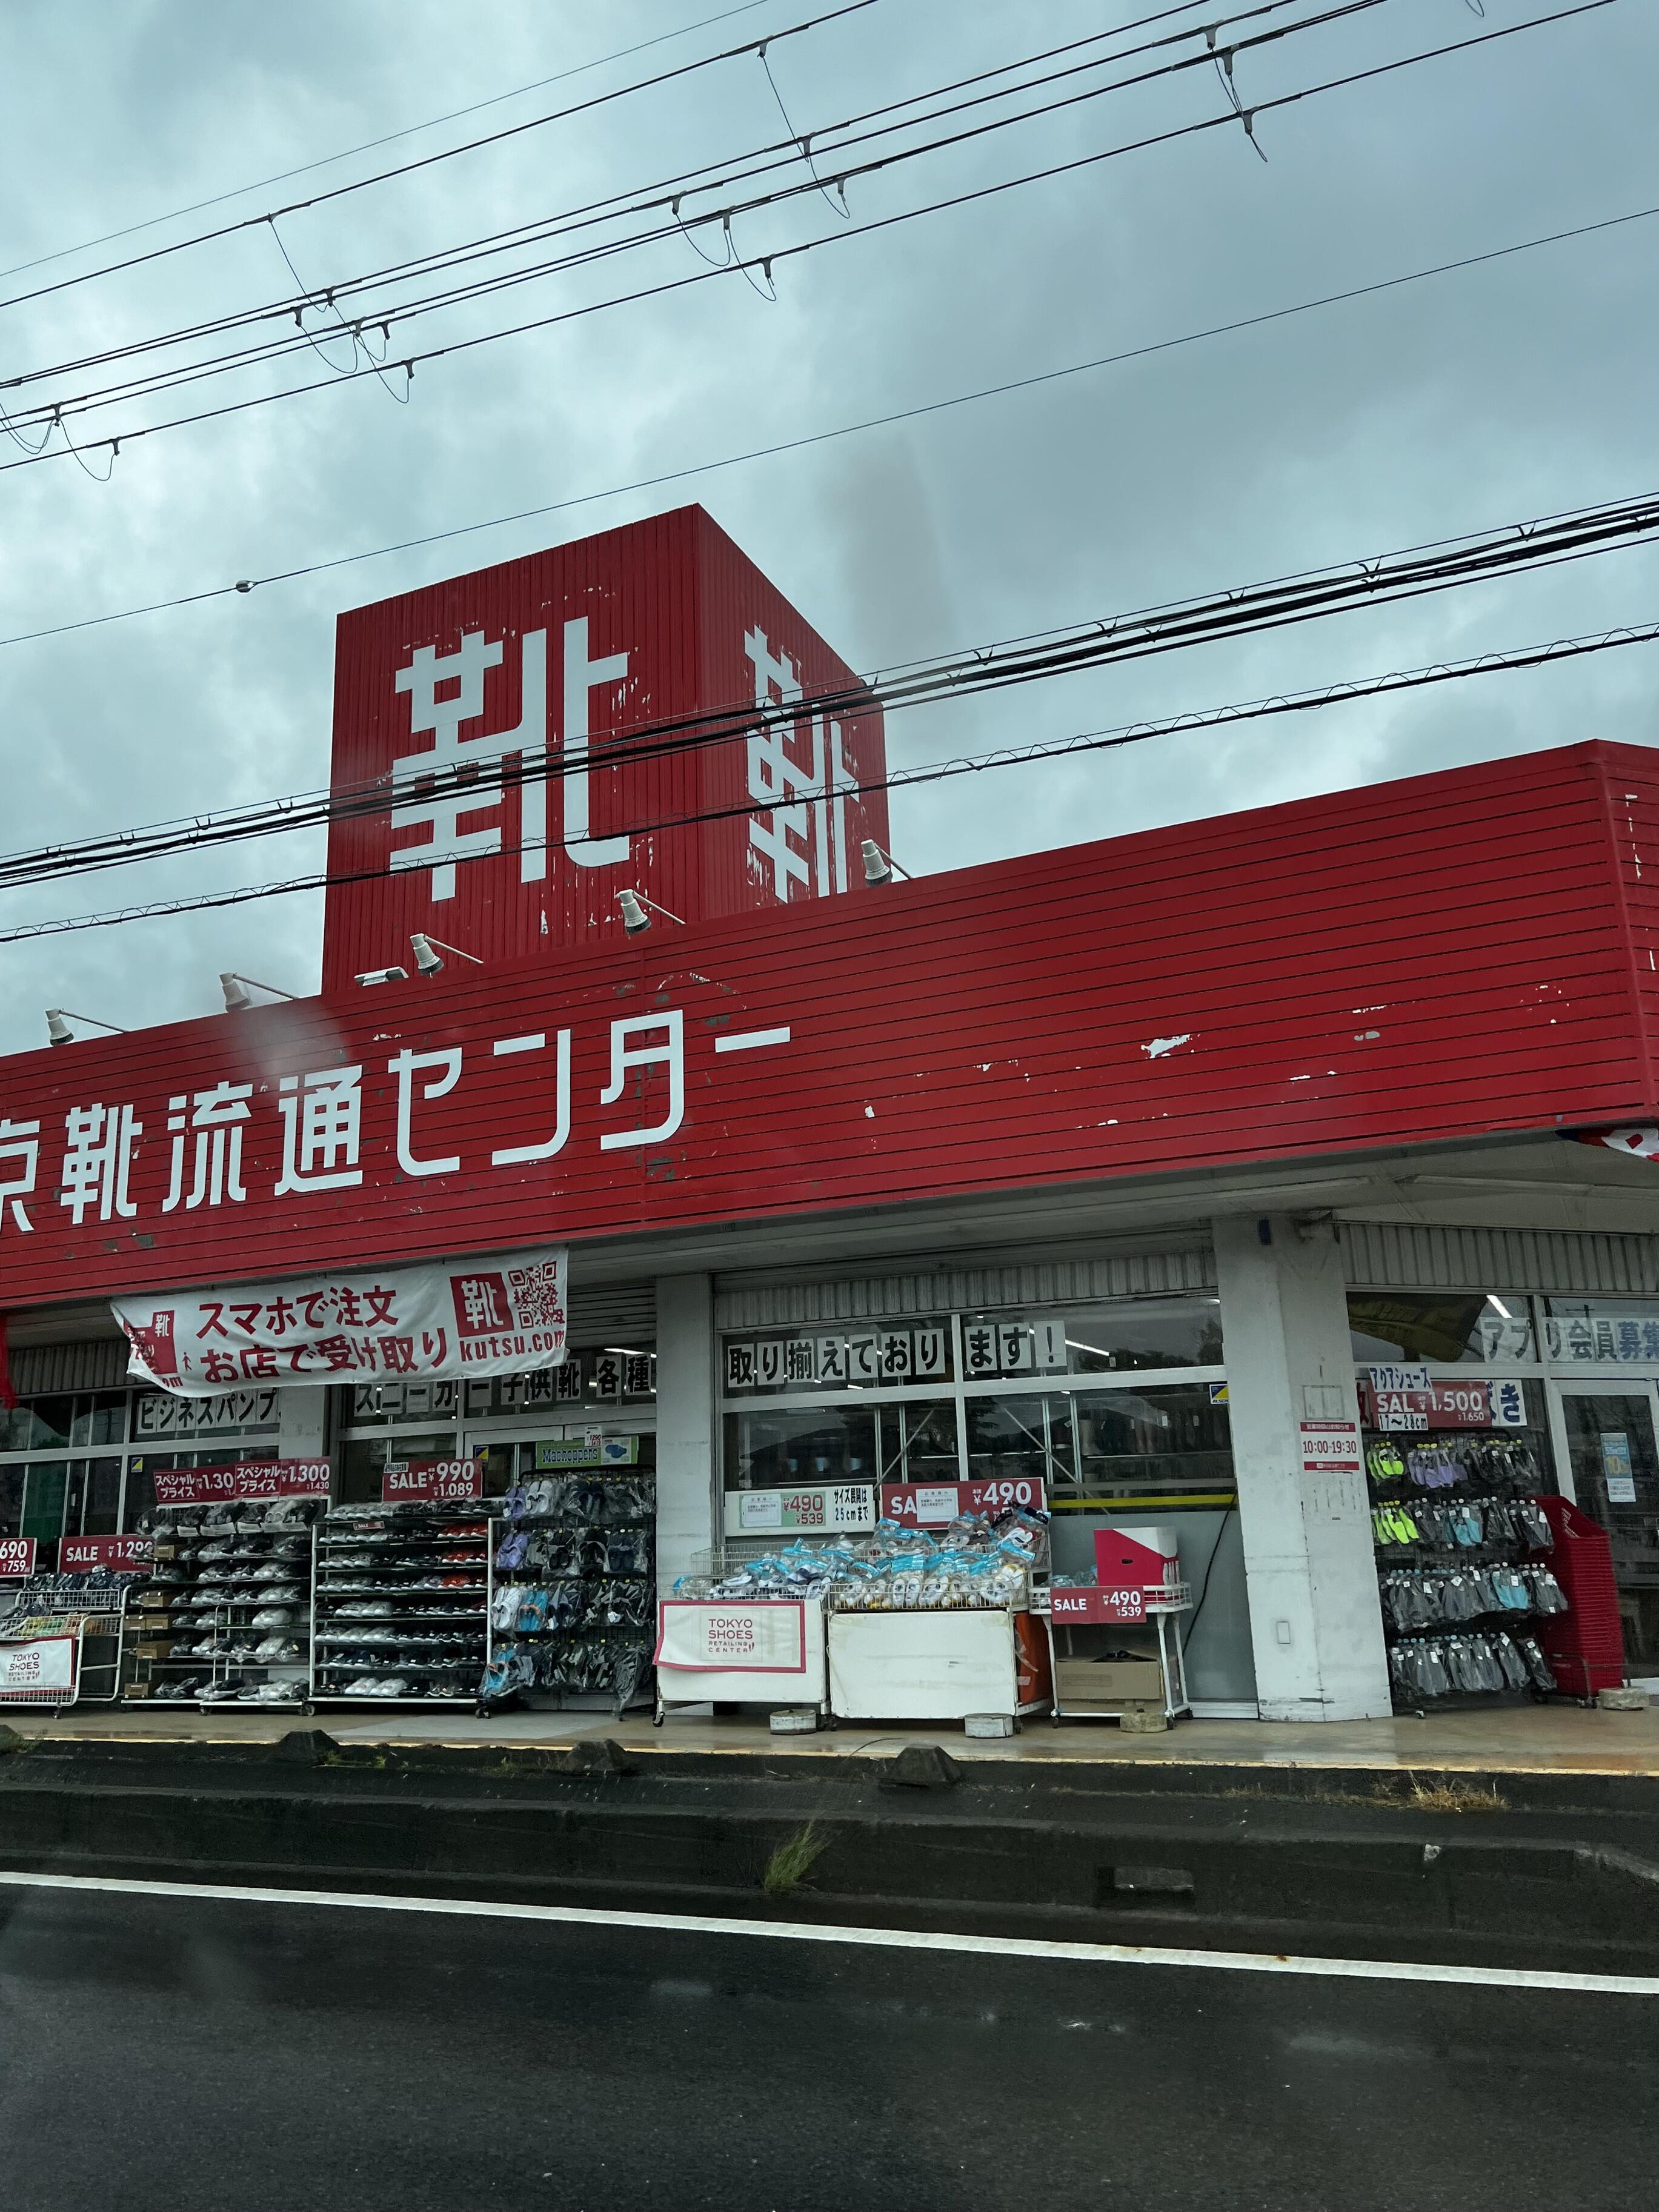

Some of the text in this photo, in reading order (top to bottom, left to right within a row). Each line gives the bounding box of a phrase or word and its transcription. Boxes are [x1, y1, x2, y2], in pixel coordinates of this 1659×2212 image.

[390, 616, 630, 902] 靴
[743, 624, 859, 903] 靴
[196, 1285, 397, 1338] スマホで注文
[461, 1280, 505, 1329] 靴
[155, 1314, 170, 1337] 靴
[459, 1329, 565, 1362] kutsu.com
[201, 1327, 447, 1384] お店で受け取り
[141, 1387, 281, 1430] ビジネスパンプ
[155, 1473, 196, 1486] スペシャル
[236, 1464, 281, 1479] スペシャル
[240, 1479, 276, 1492] プライス
[390, 1472, 427, 1489] SALE
[160, 1486, 195, 1499] プライス
[891, 1496, 918, 1515] SA
[66, 1546, 99, 1562] SALE
[1054, 1598, 1087, 1612] SALE
[708, 1619, 753, 1629] TOKYO
[708, 1630, 753, 1639] SHOES
[13, 1652, 40, 1662] TOKYO
[9, 1661, 39, 1671] SHOES
